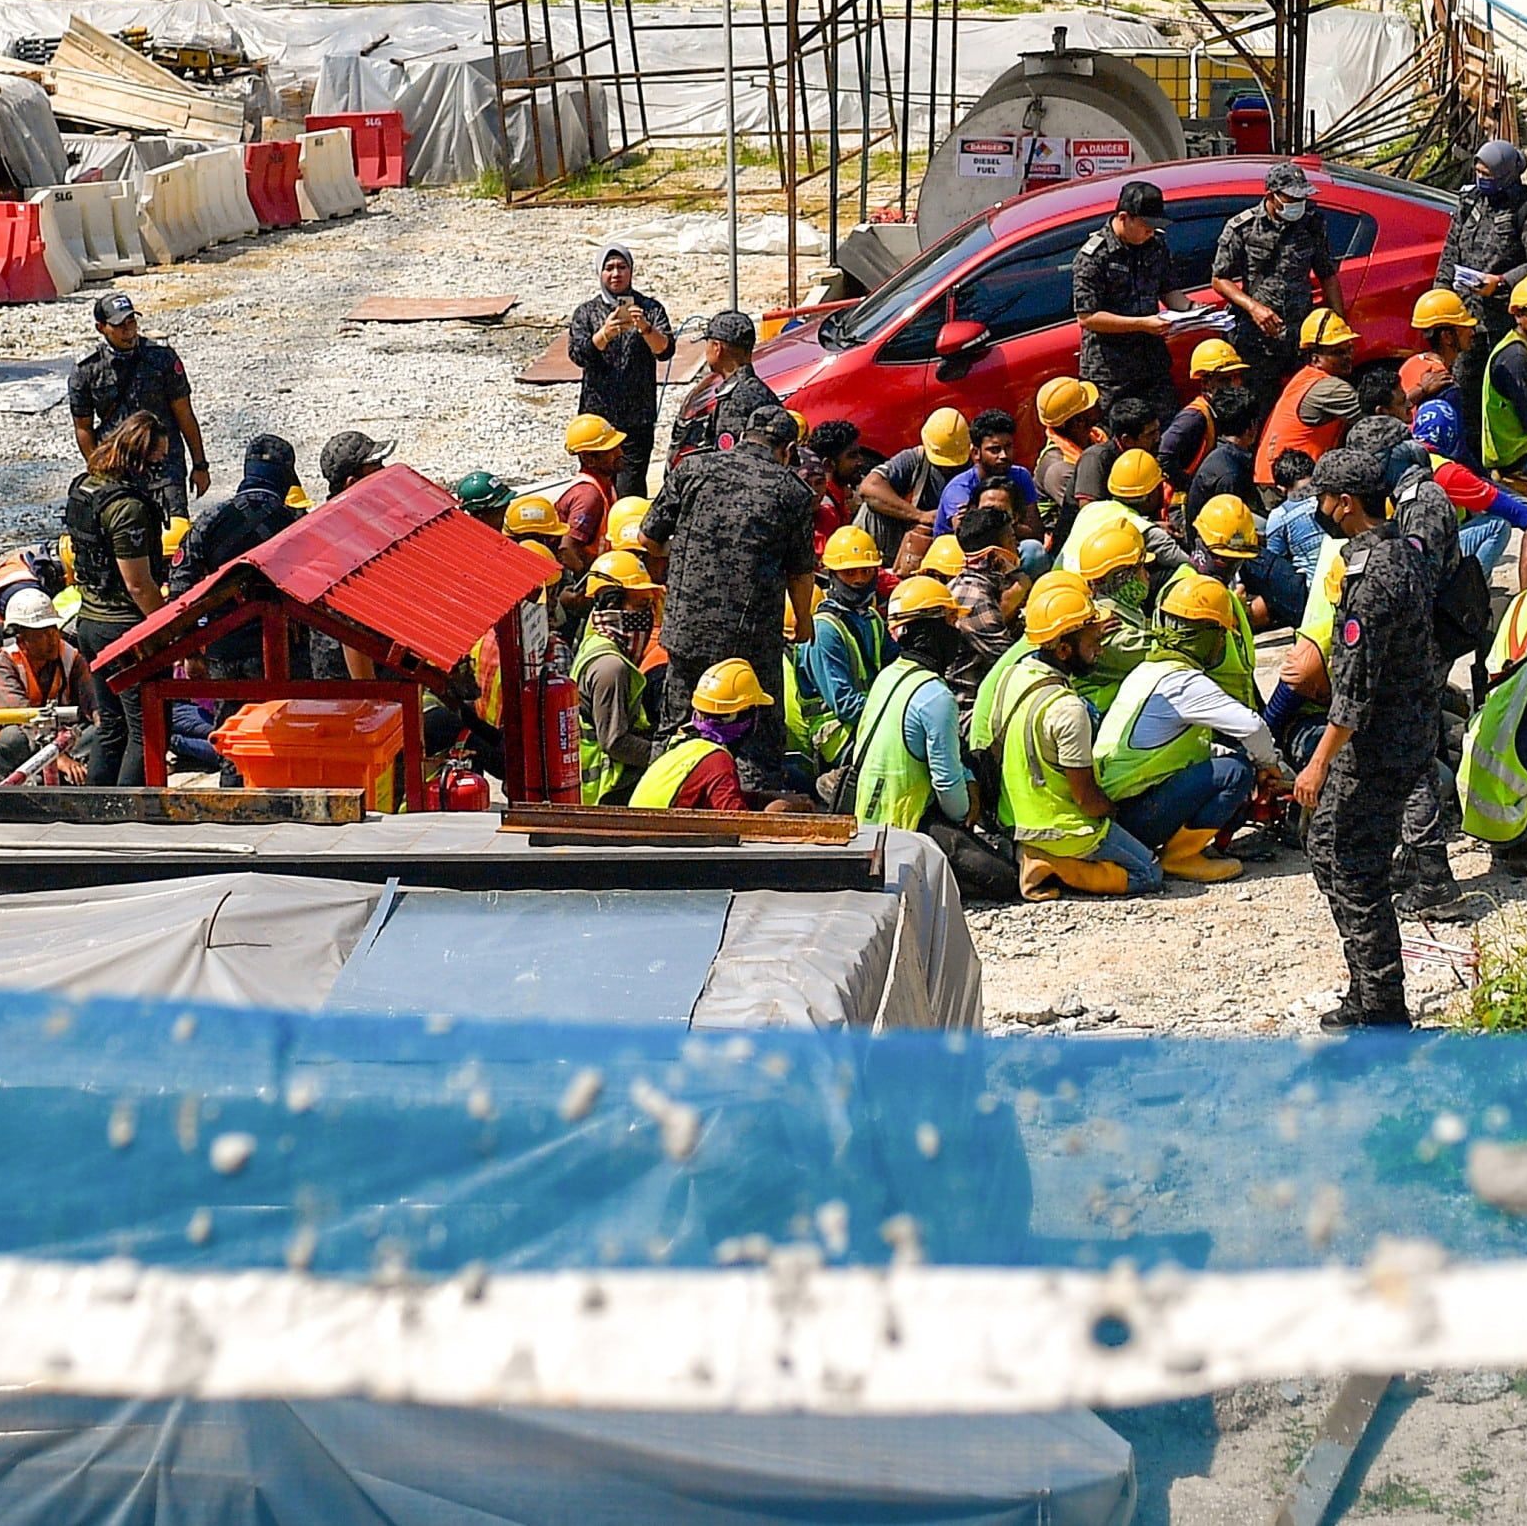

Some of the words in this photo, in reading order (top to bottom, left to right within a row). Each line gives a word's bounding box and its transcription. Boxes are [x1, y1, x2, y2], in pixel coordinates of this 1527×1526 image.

[365, 117, 382, 127] SLG
[1090, 144, 1124, 154] DANGER
[973, 158, 1002, 166] DIESEL
[976, 166, 998, 175] FUEL
[54, 191, 73, 202] SLG
